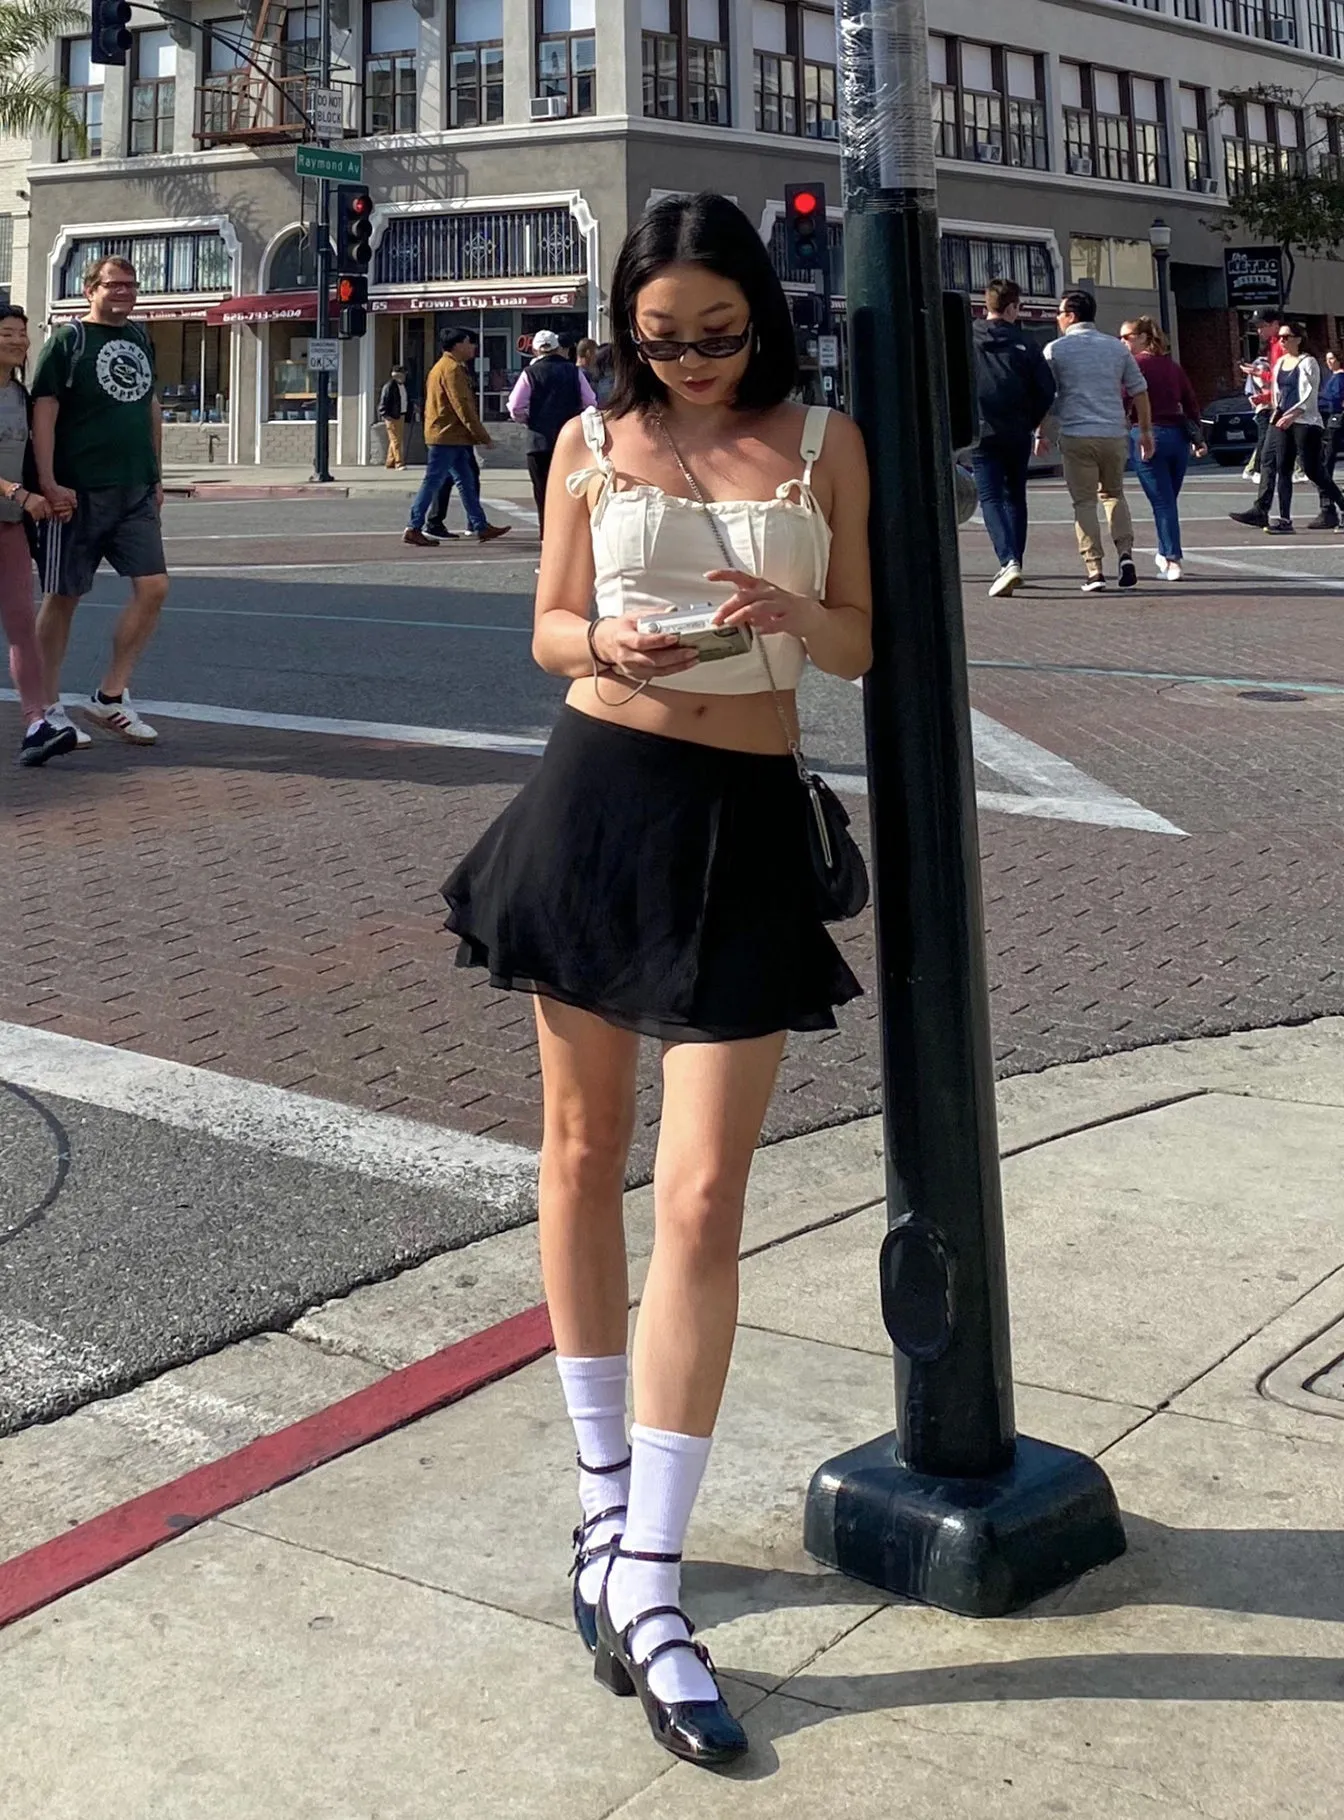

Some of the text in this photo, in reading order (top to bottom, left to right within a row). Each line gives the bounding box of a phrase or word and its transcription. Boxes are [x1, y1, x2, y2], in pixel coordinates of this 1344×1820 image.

[317, 95, 342, 108] DO NOT
[317, 111, 342, 123] BLOCK
[298, 154, 360, 174] Raymond Av
[1227, 258, 1279, 275] RETRO
[371, 294, 569, 311] 65 Crown City Loan 65
[100, 343, 145, 364] ISLAND
[101, 374, 149, 400] HOPPER
